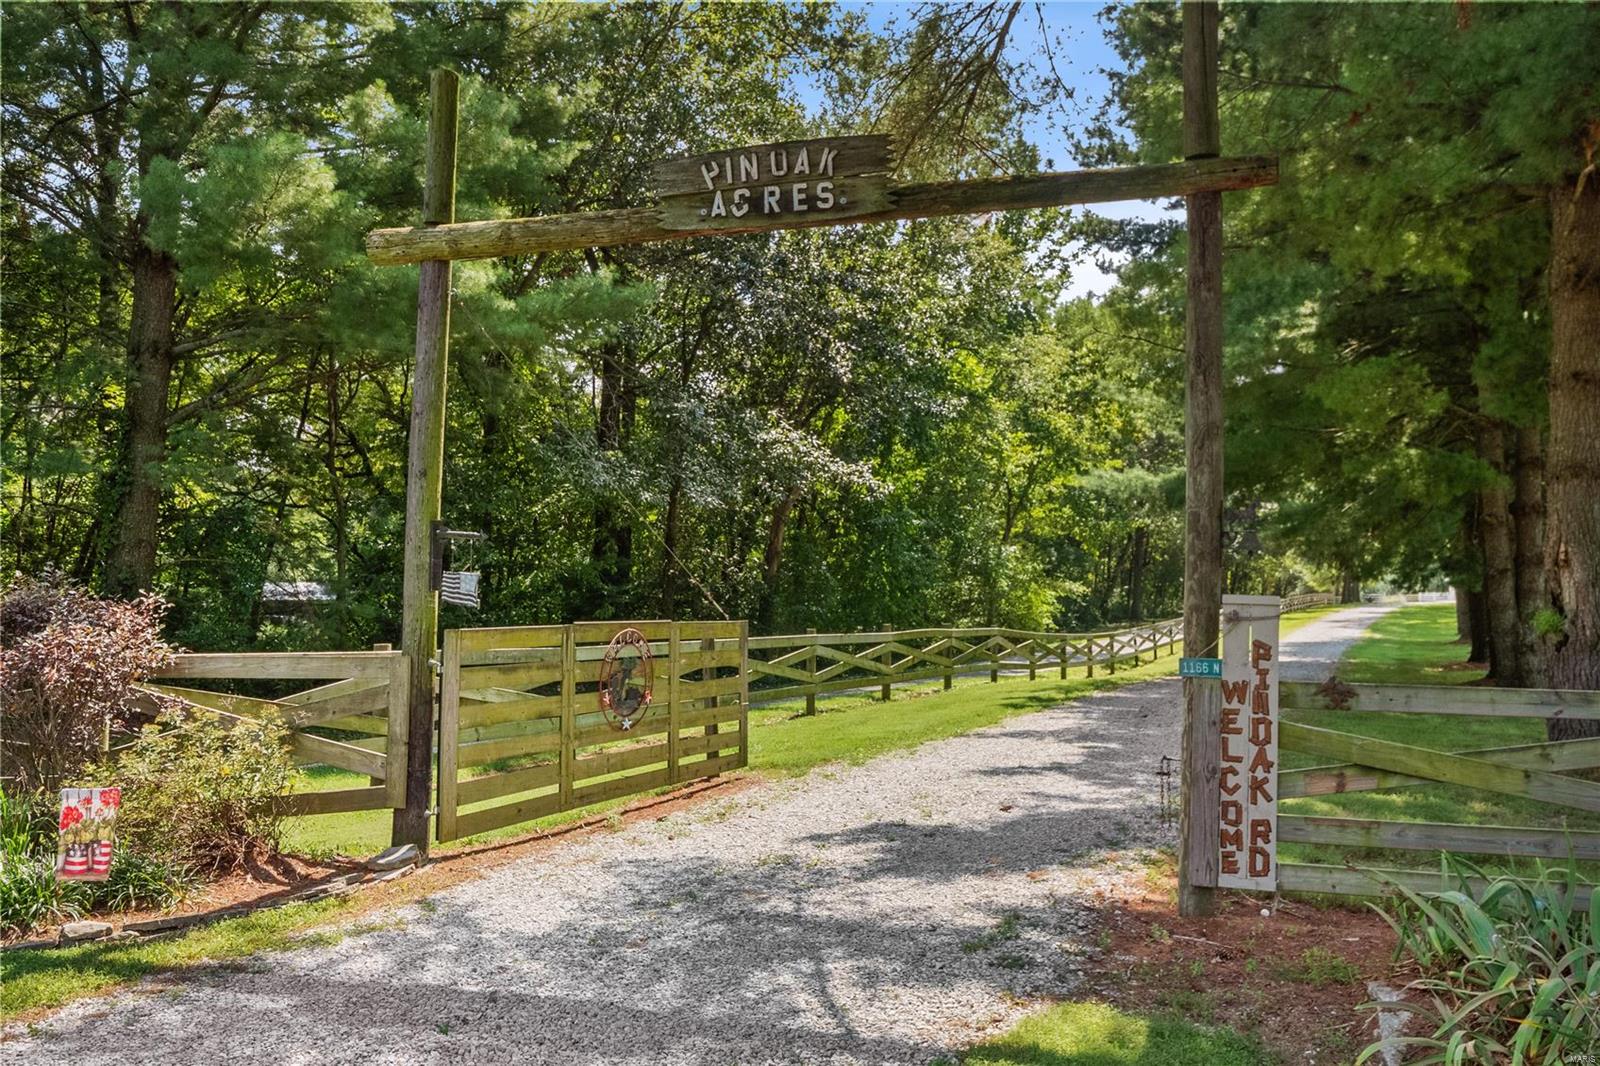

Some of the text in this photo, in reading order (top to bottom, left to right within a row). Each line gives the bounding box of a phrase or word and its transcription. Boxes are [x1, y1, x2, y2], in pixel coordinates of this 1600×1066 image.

[711, 181, 835, 218] ACRES
[1182, 661, 1220, 674] 1166 N
[1219, 679, 1249, 876] WELCOME
[1248, 818, 1273, 878] RD
